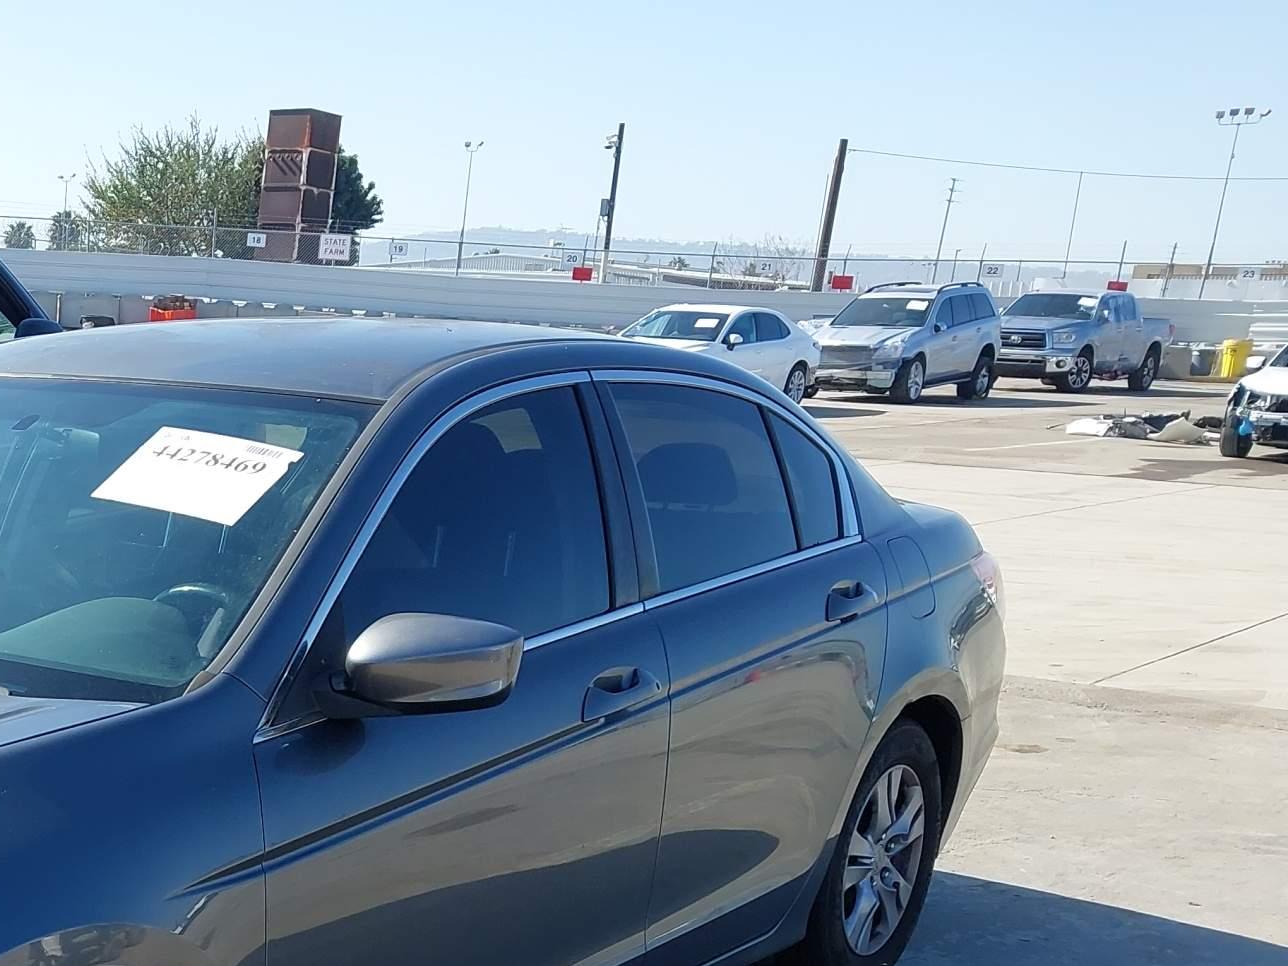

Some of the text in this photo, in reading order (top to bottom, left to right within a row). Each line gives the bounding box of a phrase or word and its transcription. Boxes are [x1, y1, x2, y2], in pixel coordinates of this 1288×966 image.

[251, 236, 262, 244] 18
[324, 238, 347, 247] STATE
[323, 248, 345, 256] FARM
[393, 245, 403, 253] 19
[566, 254, 578, 263] 20
[760, 263, 772, 271] 21
[986, 266, 999, 275] 22
[1242, 270, 1255, 279] 23
[152, 445, 267, 474] 44278469
